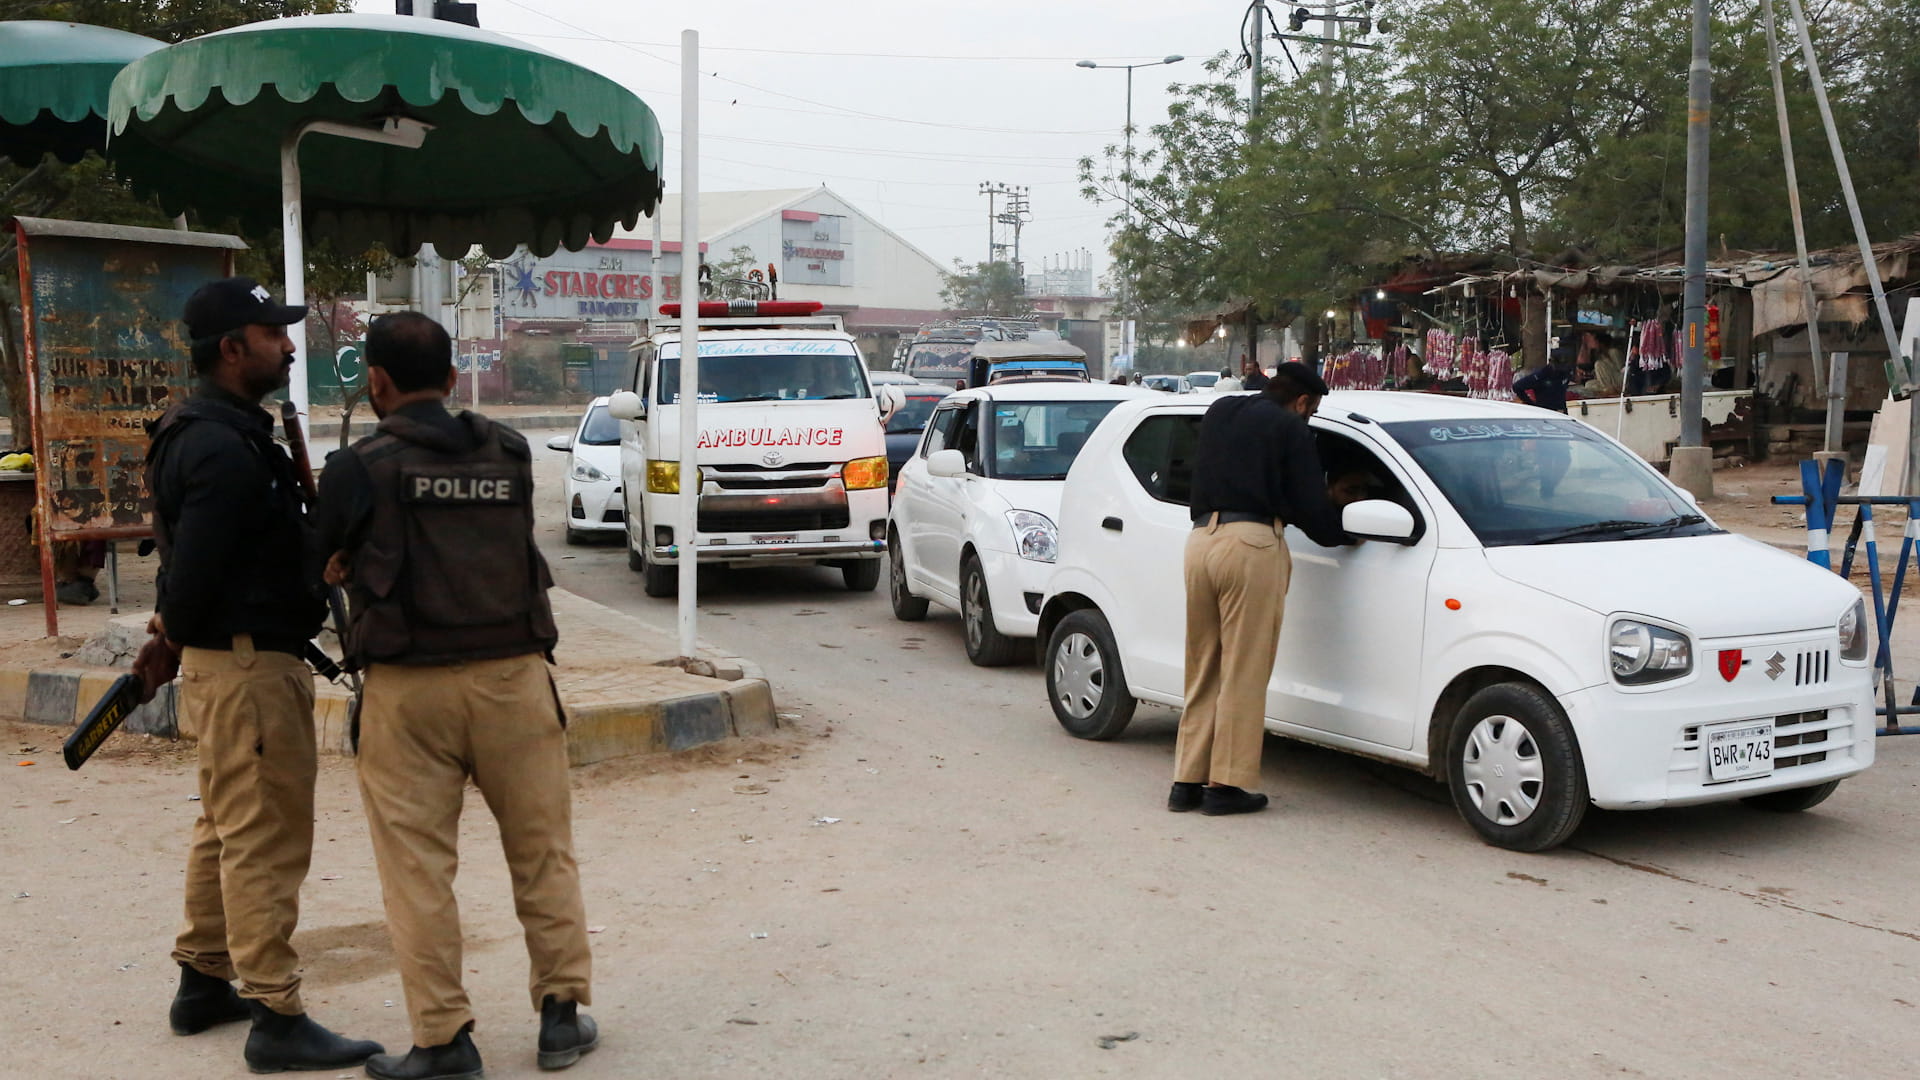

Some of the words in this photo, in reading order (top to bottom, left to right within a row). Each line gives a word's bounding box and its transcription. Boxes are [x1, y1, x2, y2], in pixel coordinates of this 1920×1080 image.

[697, 427, 843, 449] AMBULANCE
[415, 477, 510, 499] POLICE
[80, 704, 119, 756] GARRETT
[1713, 744, 1738, 767] BWR
[1747, 740, 1770, 762] 743
